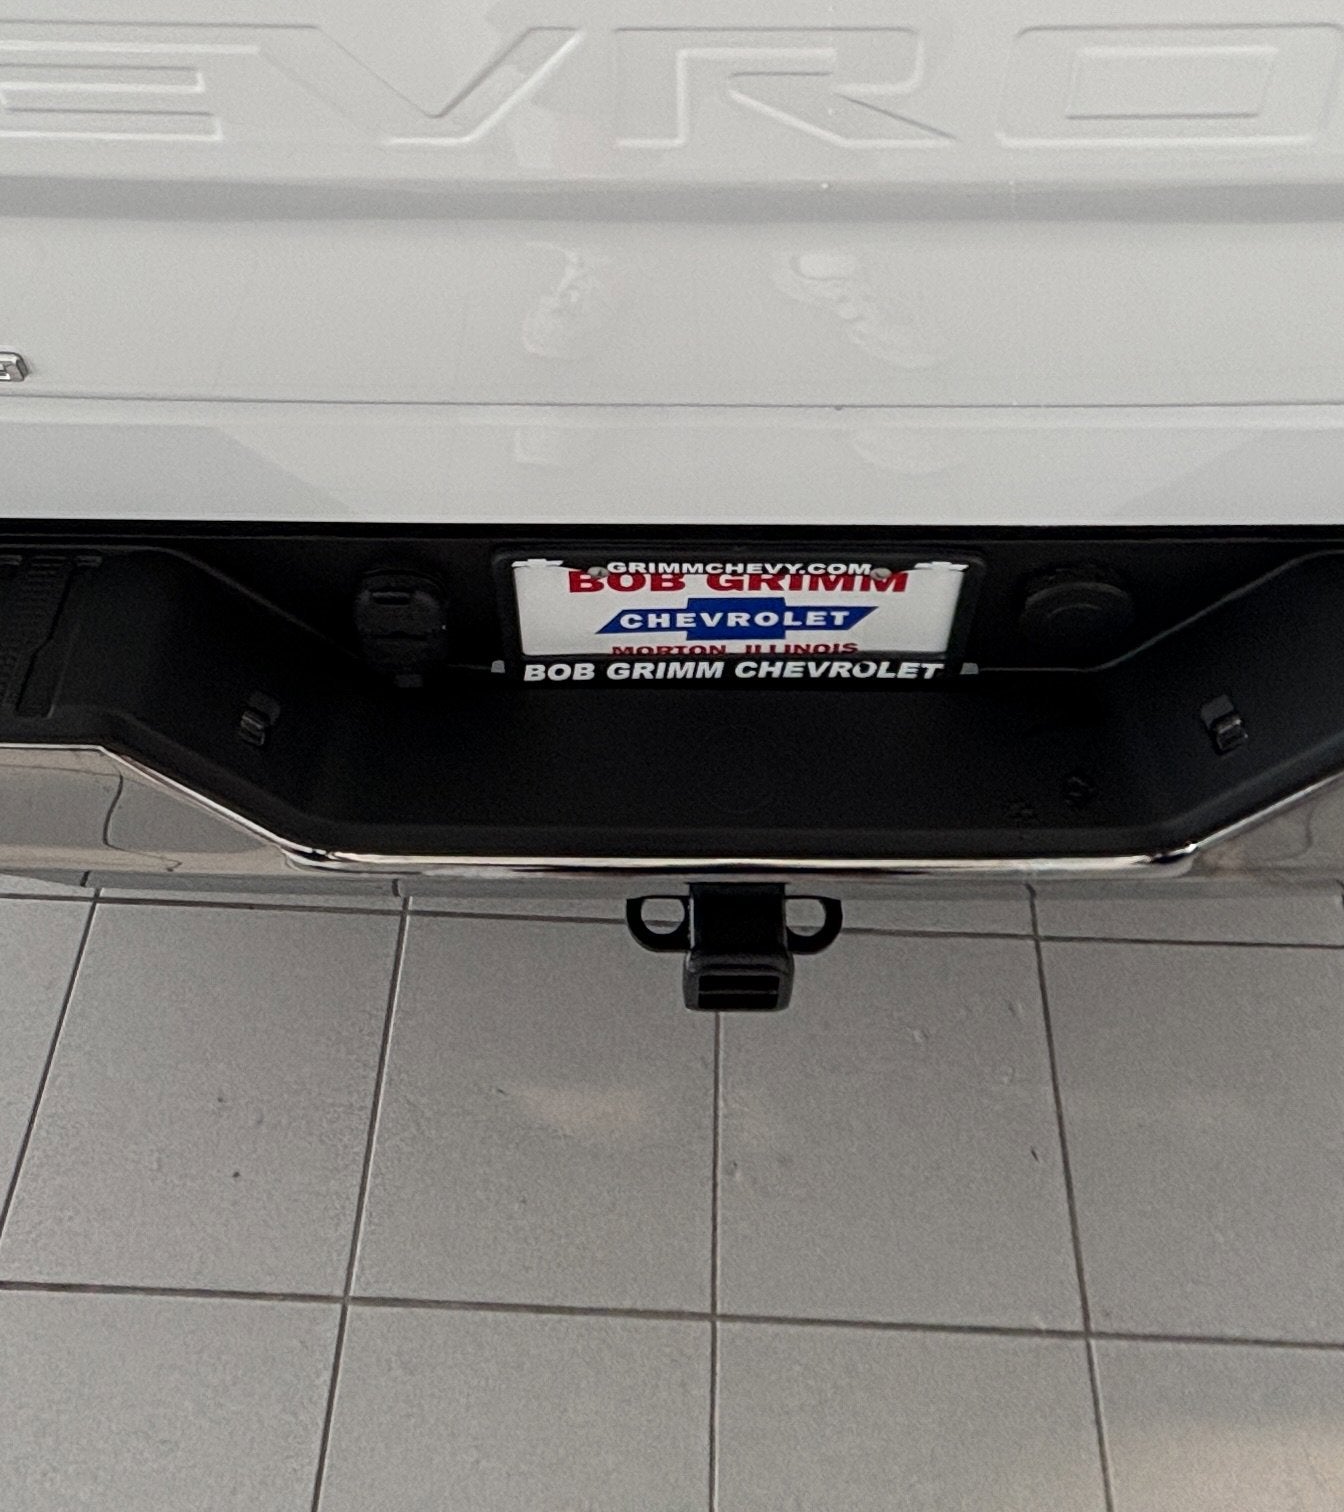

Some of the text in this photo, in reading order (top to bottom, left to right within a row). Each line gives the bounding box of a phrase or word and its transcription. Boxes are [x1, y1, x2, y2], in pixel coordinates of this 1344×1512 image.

[607, 561, 872, 575] GRIMMCHEVY.COM
[568, 571, 909, 593] BOB GRIMM
[619, 611, 850, 629] CHEVROLET
[611, 644, 727, 657] MORTON
[523, 660, 945, 682] BOB GRIMM CHEVROLET
